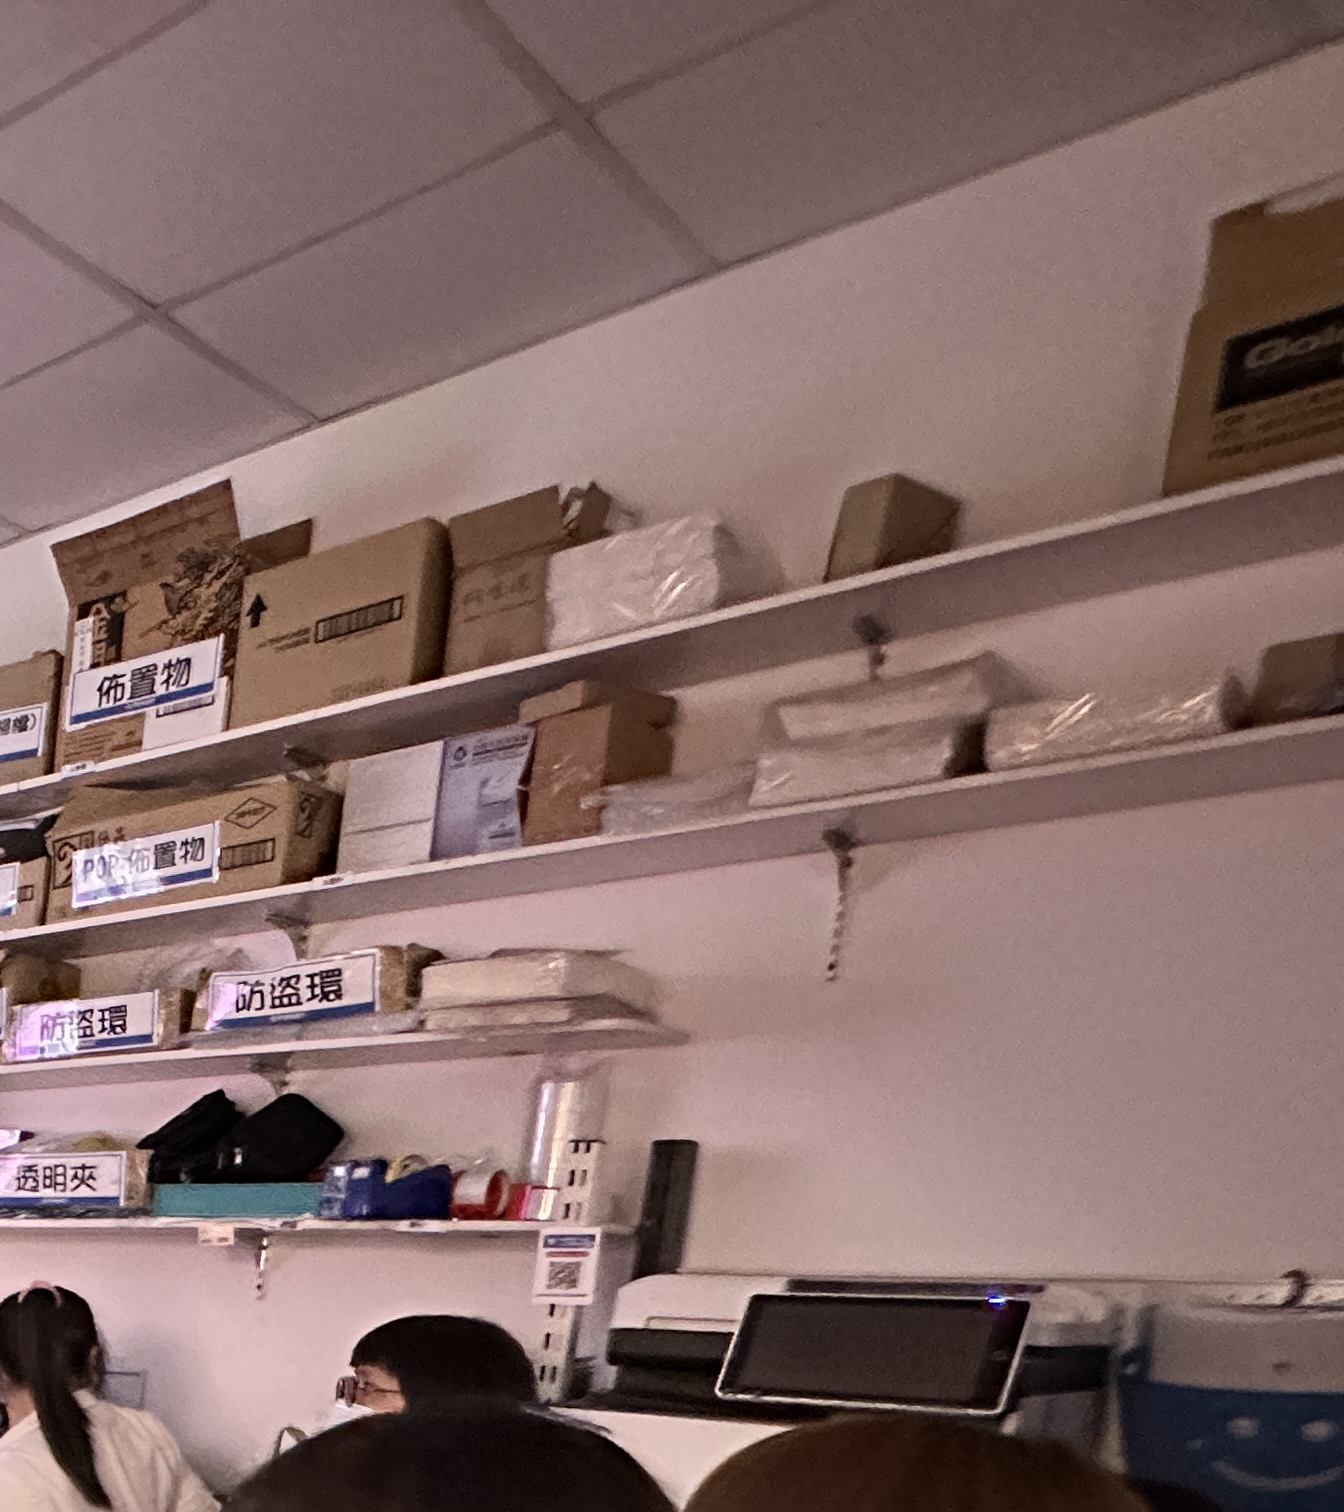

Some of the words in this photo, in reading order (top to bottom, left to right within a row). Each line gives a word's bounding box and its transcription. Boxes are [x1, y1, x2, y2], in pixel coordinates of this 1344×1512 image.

[96, 655, 192, 709] 佈置物
[82, 854, 118, 881] POP
[128, 836, 206, 876] 佈置物
[236, 967, 344, 1013] 防盜環
[15, 1163, 98, 1194] 透明夾
